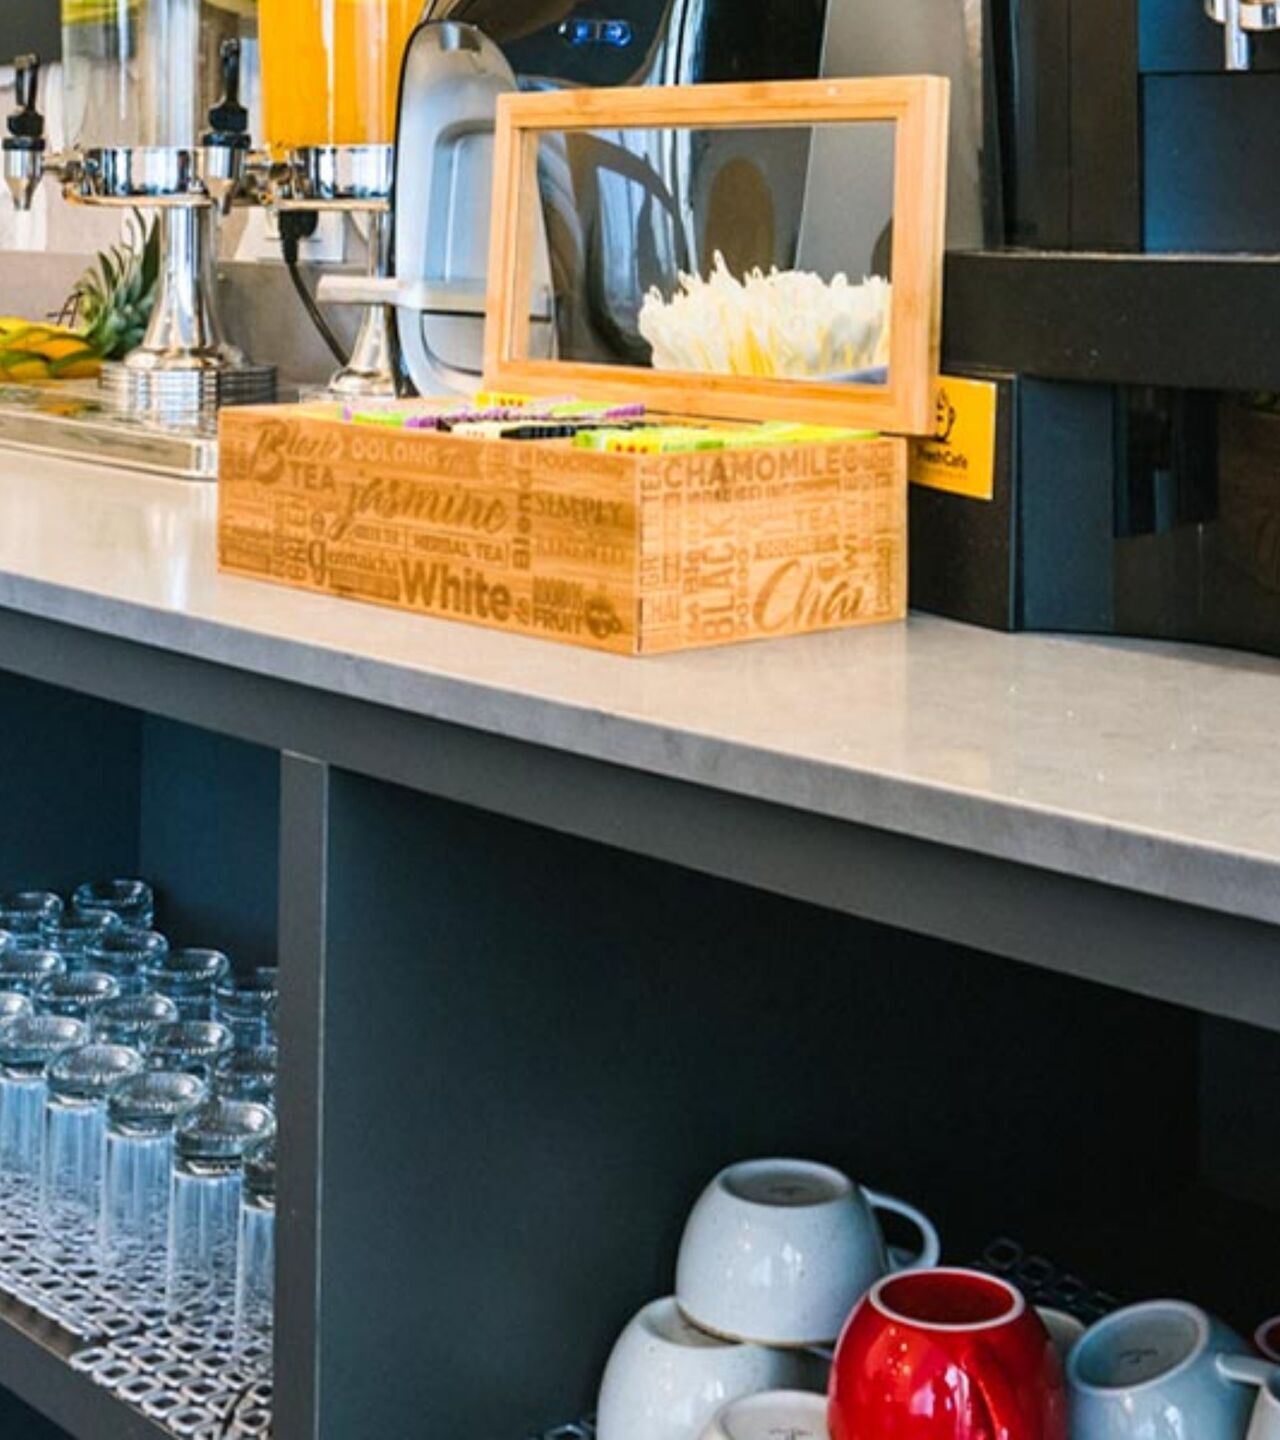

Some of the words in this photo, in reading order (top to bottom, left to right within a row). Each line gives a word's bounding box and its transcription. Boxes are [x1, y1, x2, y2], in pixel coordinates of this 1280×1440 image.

[287, 461, 337, 494] TEA
[663, 445, 841, 488] CHAMOMILE
[319, 469, 507, 541] jasmine
[399, 557, 514, 622] White
[701, 513, 736, 638] BLACK
[752, 559, 870, 633] Chai
[533, 606, 583, 636] FRUIT
